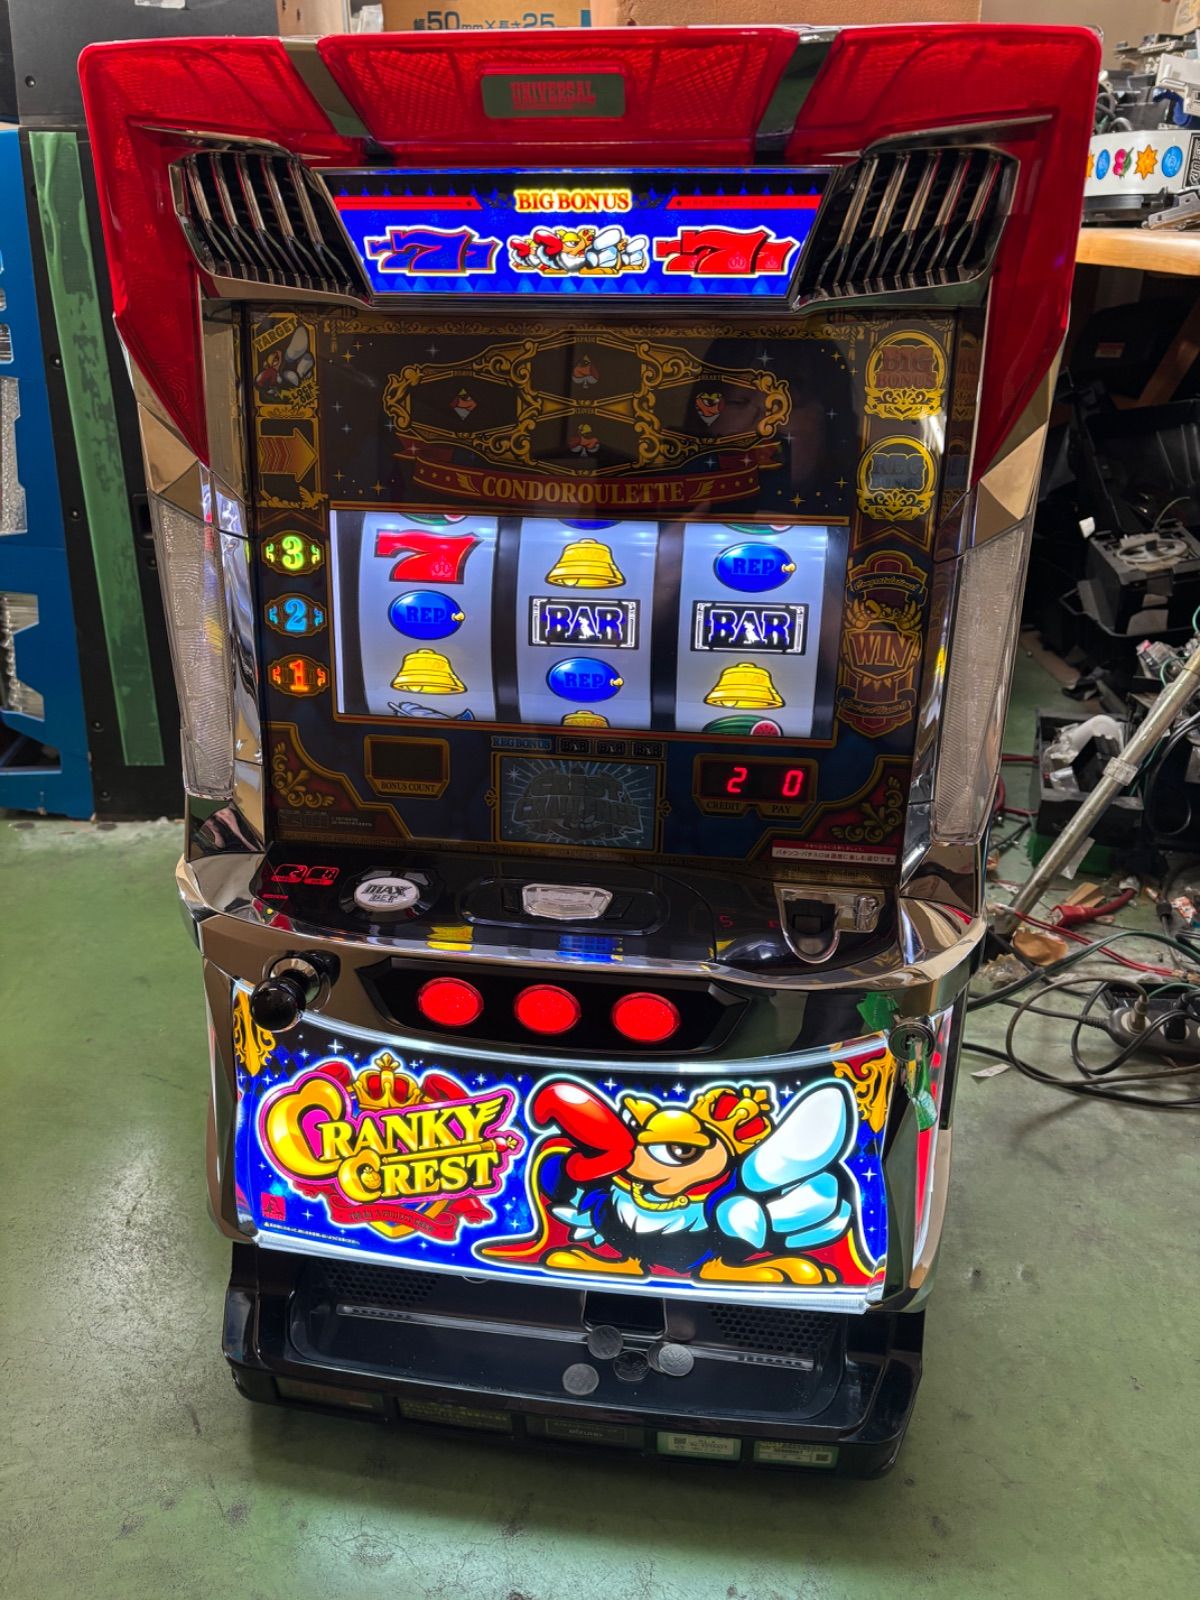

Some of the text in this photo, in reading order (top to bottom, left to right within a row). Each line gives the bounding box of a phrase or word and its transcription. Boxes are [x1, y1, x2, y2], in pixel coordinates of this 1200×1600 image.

[508, 80, 597, 107] UNIVERSAL
[516, 192, 629, 210] BIG BONUS
[253, 315, 298, 353] TARGET
[882, 346, 933, 372] BIG
[482, 476, 685, 505] CONDOROULETTE
[282, 536, 304, 570] 3
[732, 557, 776, 576] REP
[284, 598, 307, 632] 2
[405, 605, 445, 624] REP
[544, 605, 624, 640] BAR
[708, 610, 791, 645] BAR
[852, 633, 914, 668] WIN
[288, 660, 309, 692] 1
[564, 672, 604, 689] REP
[381, 782, 436, 793] BONUS COUNT
[726, 767, 748, 794] 2
[781, 769, 804, 797] 0
[706, 801, 740, 811] CREDIT
[771, 804, 792, 814] PAY
[361, 883, 412, 897] MAX
[267, 1078, 504, 1177] CRANKY
[337, 1149, 499, 1203] CREST
